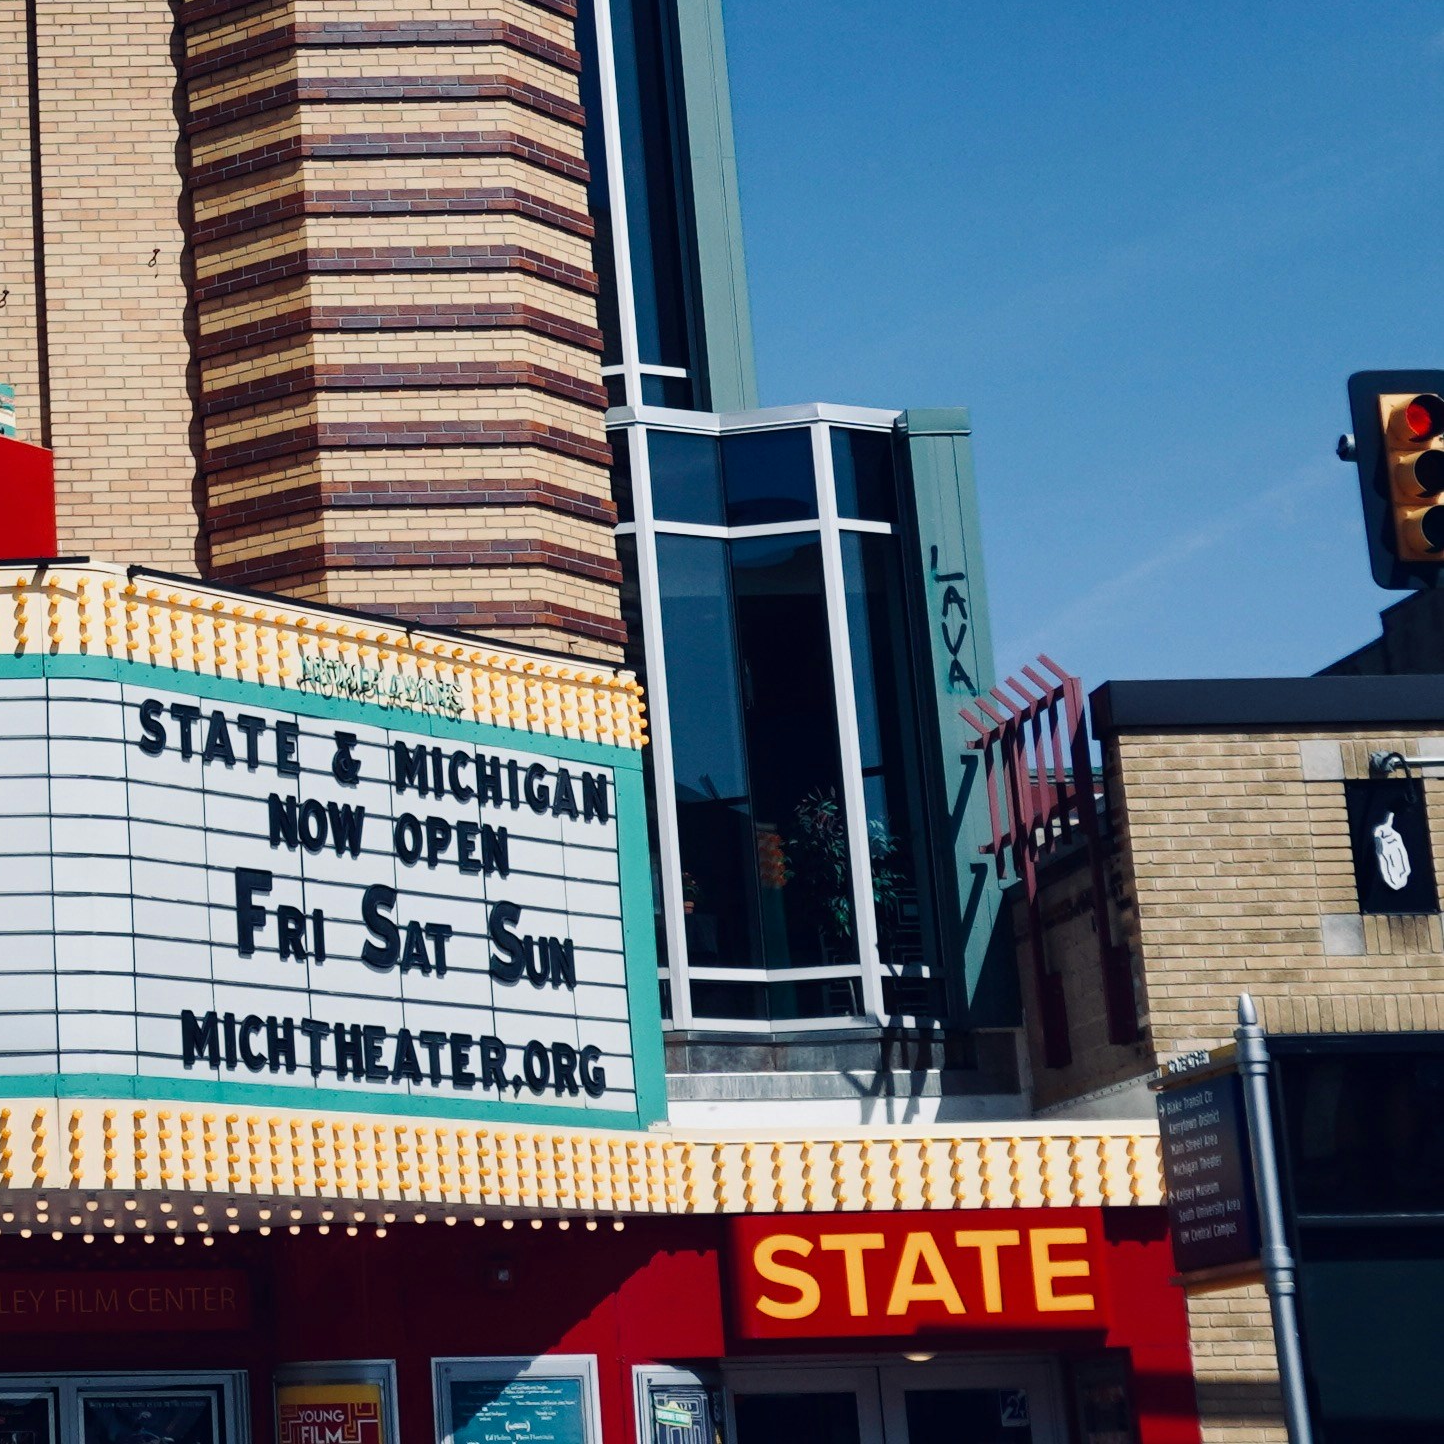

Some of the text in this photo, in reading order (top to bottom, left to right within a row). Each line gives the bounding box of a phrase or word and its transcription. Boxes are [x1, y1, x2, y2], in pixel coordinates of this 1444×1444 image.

[138, 699, 609, 823] STATE & MICHIGAN
[269, 793, 510, 877] NOW OPEN
[1171, 1141, 1184, 1155] Main
[1185, 1137, 1203, 1152] Street
[752, 1228, 1095, 1319] STATE
[54, 1289, 119, 1313] FILM
[128, 1287, 236, 1312] CENTER
[298, 1410, 344, 1422] YOUNG
[301, 1426, 342, 1444] FILM
